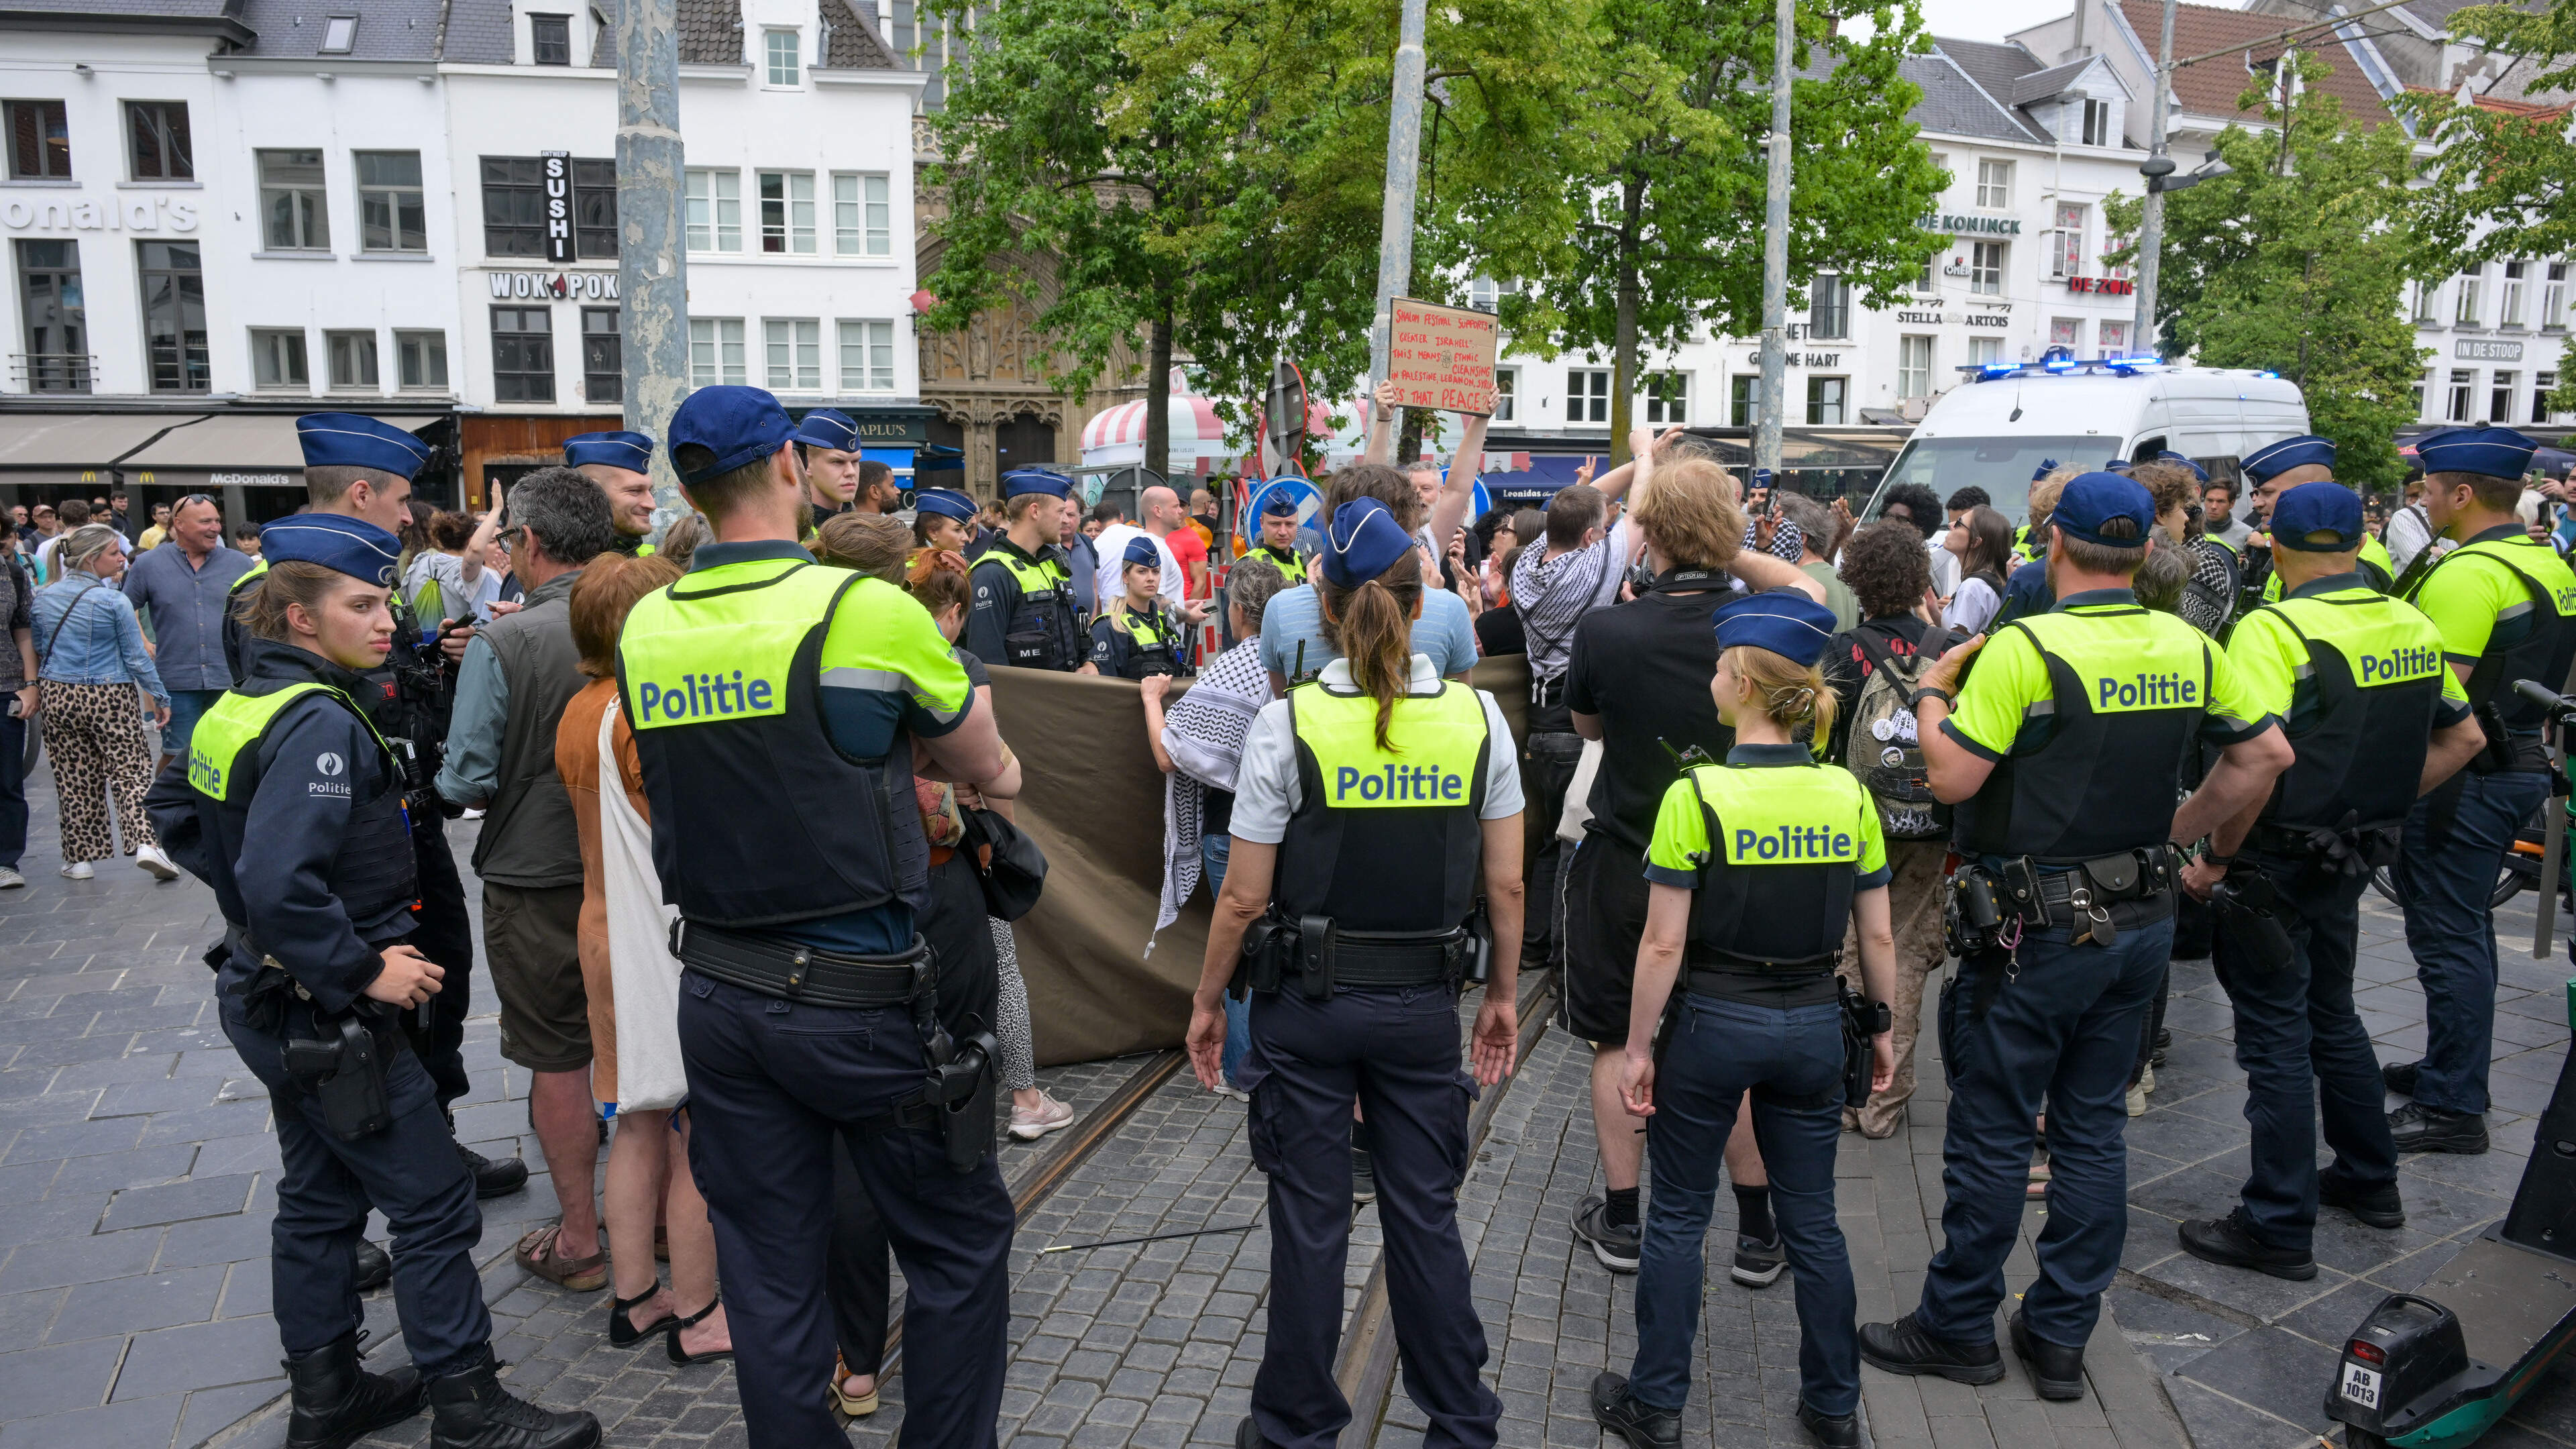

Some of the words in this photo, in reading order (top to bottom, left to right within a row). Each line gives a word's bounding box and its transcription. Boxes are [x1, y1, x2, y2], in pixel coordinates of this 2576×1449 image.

[546, 158, 568, 258] SUSHI
[1917, 214, 1939, 229] DE
[1943, 215, 2021, 234] KONINCK
[489, 273, 548, 299] WOK
[569, 274, 620, 299] POK
[2070, 277, 2094, 292] DE
[2096, 279, 2133, 295] ZON
[1396, 309, 1419, 323] SHALOM
[1458, 318, 1488, 331] SUPPORTS
[1897, 311, 1942, 324] STELLA
[1966, 315, 2008, 327] ARTOIS
[1418, 350, 1441, 362] MEANS
[2458, 342, 2471, 356] IN
[2473, 343, 2487, 357] DE
[2489, 343, 2521, 358] STOOP
[1806, 353, 1840, 366] HART
[1411, 390, 1434, 406] THAT
[859, 425, 906, 436] APLU'S
[210, 473, 289, 484] McDonald's
[1503, 490, 1541, 498] Leonidas
[975, 599, 993, 608] Politie
[1020, 649, 1040, 657] ME
[2360, 645, 2436, 682] Politie
[641, 669, 773, 722] Politie
[2099, 672, 2196, 708] Politie
[189, 746, 220, 794] Politie
[309, 782, 351, 795] Politie
[1337, 764, 1462, 800] Politie
[1736, 824, 1851, 860] Politie
[2353, 1370, 2371, 1387] AB
[2346, 1382, 2375, 1403] 1013
